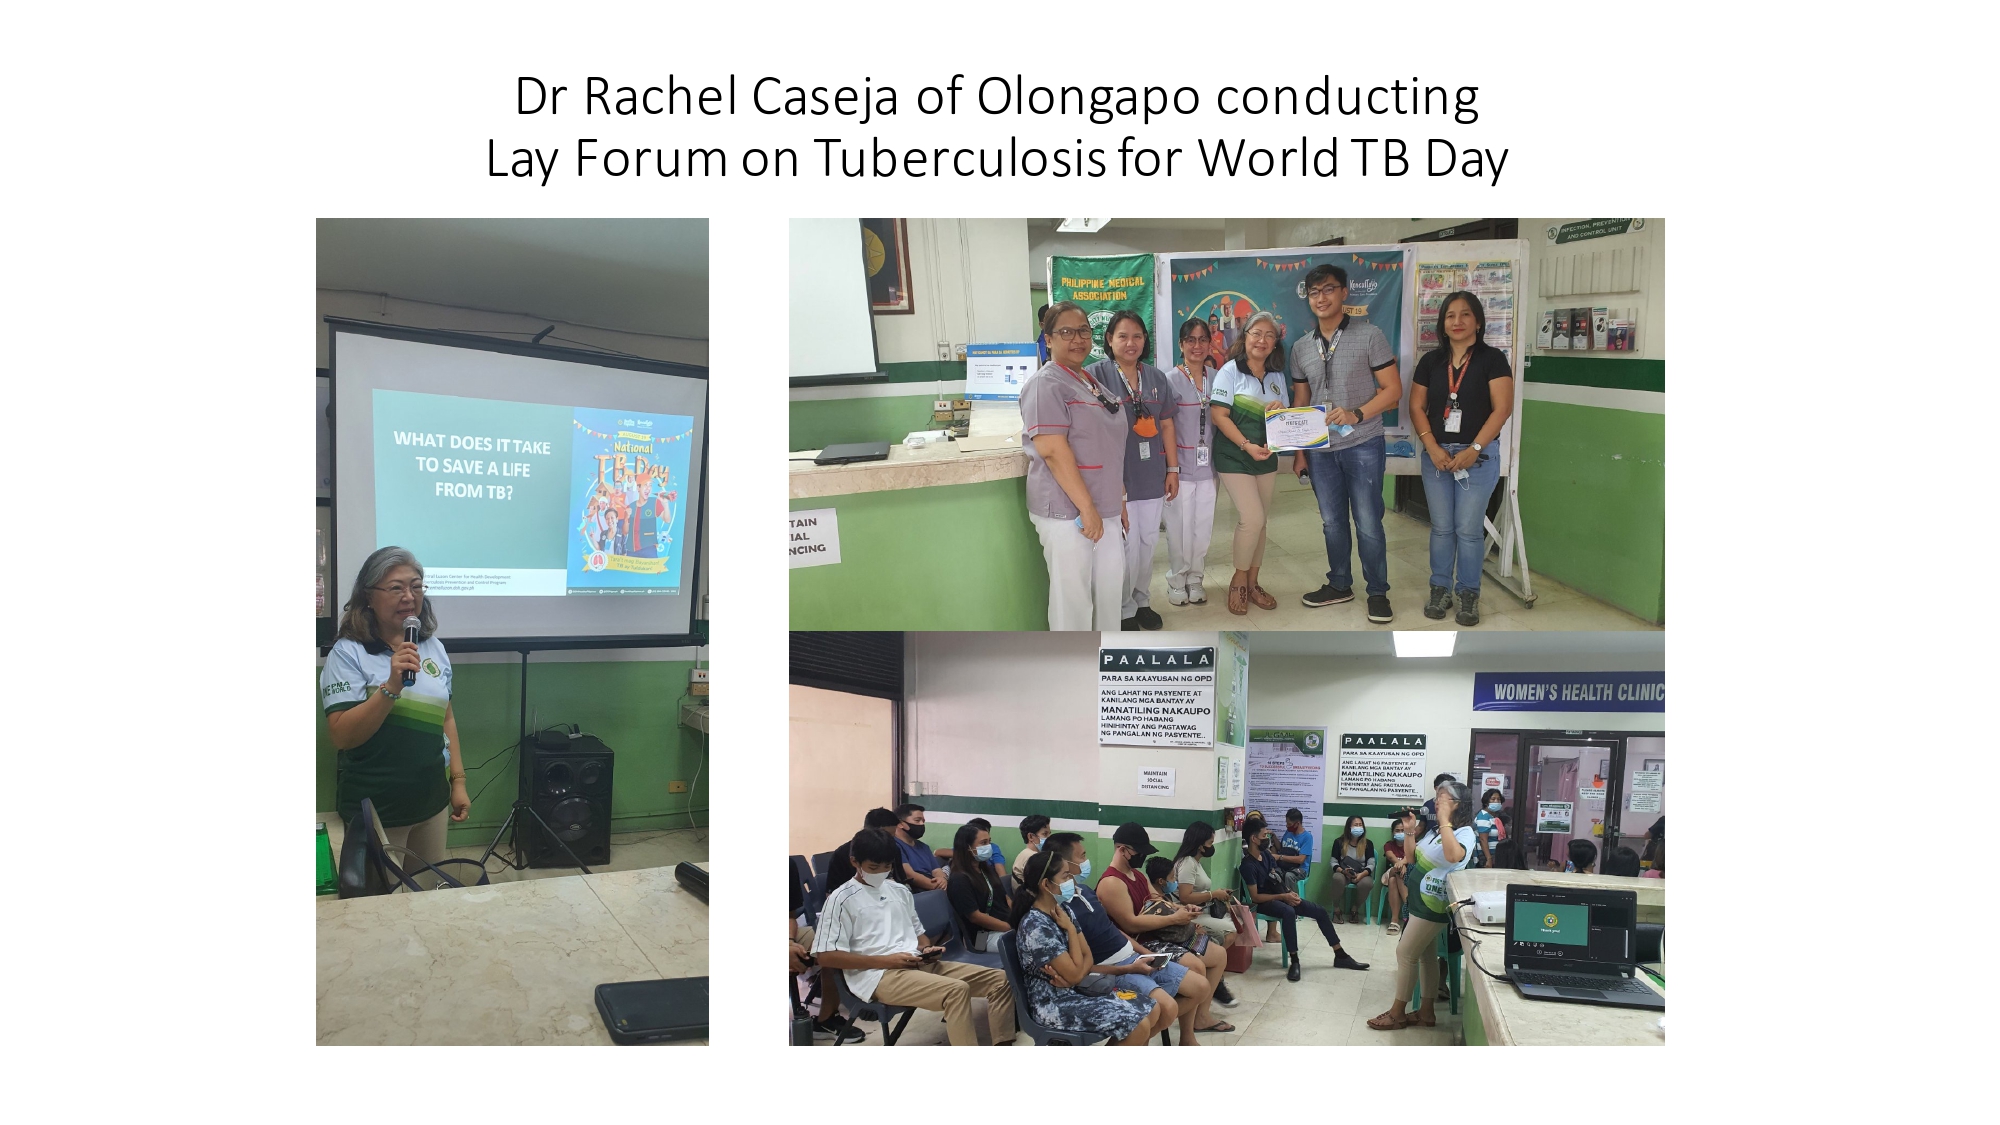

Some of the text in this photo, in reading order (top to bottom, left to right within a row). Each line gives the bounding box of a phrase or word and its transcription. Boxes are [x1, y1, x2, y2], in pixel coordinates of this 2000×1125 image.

[1580, 229, 1606, 238] CONTROL
[1061, 276, 1145, 288] PHILIPPINE MEDICAL
[1073, 291, 1127, 301] ASSOCIATION
[1342, 306, 1354, 314] UST
[393, 430, 551, 455] WHAT DOES IT TAKE
[613, 440, 653, 454] National
[415, 456, 531, 477] TO SAVE A LIFE
[593, 454, 669, 487] TB Day
[435, 482, 513, 500] FROM TB?
[789, 518, 817, 528] TAIN
[790, 532, 810, 541] IAL
[789, 544, 826, 555] NCING
[1104, 654, 1209, 665] PAALALA
[331, 681, 350, 689] PMA
[332, 685, 351, 694] WORLD
[1494, 683, 1665, 701] WOMEN'S HEALTH CLINIC
[1101, 706, 1211, 715] MANATILING NAKAUPO
[1345, 737, 1423, 745] PAALALA
[1426, 884, 1442, 894] ONE
